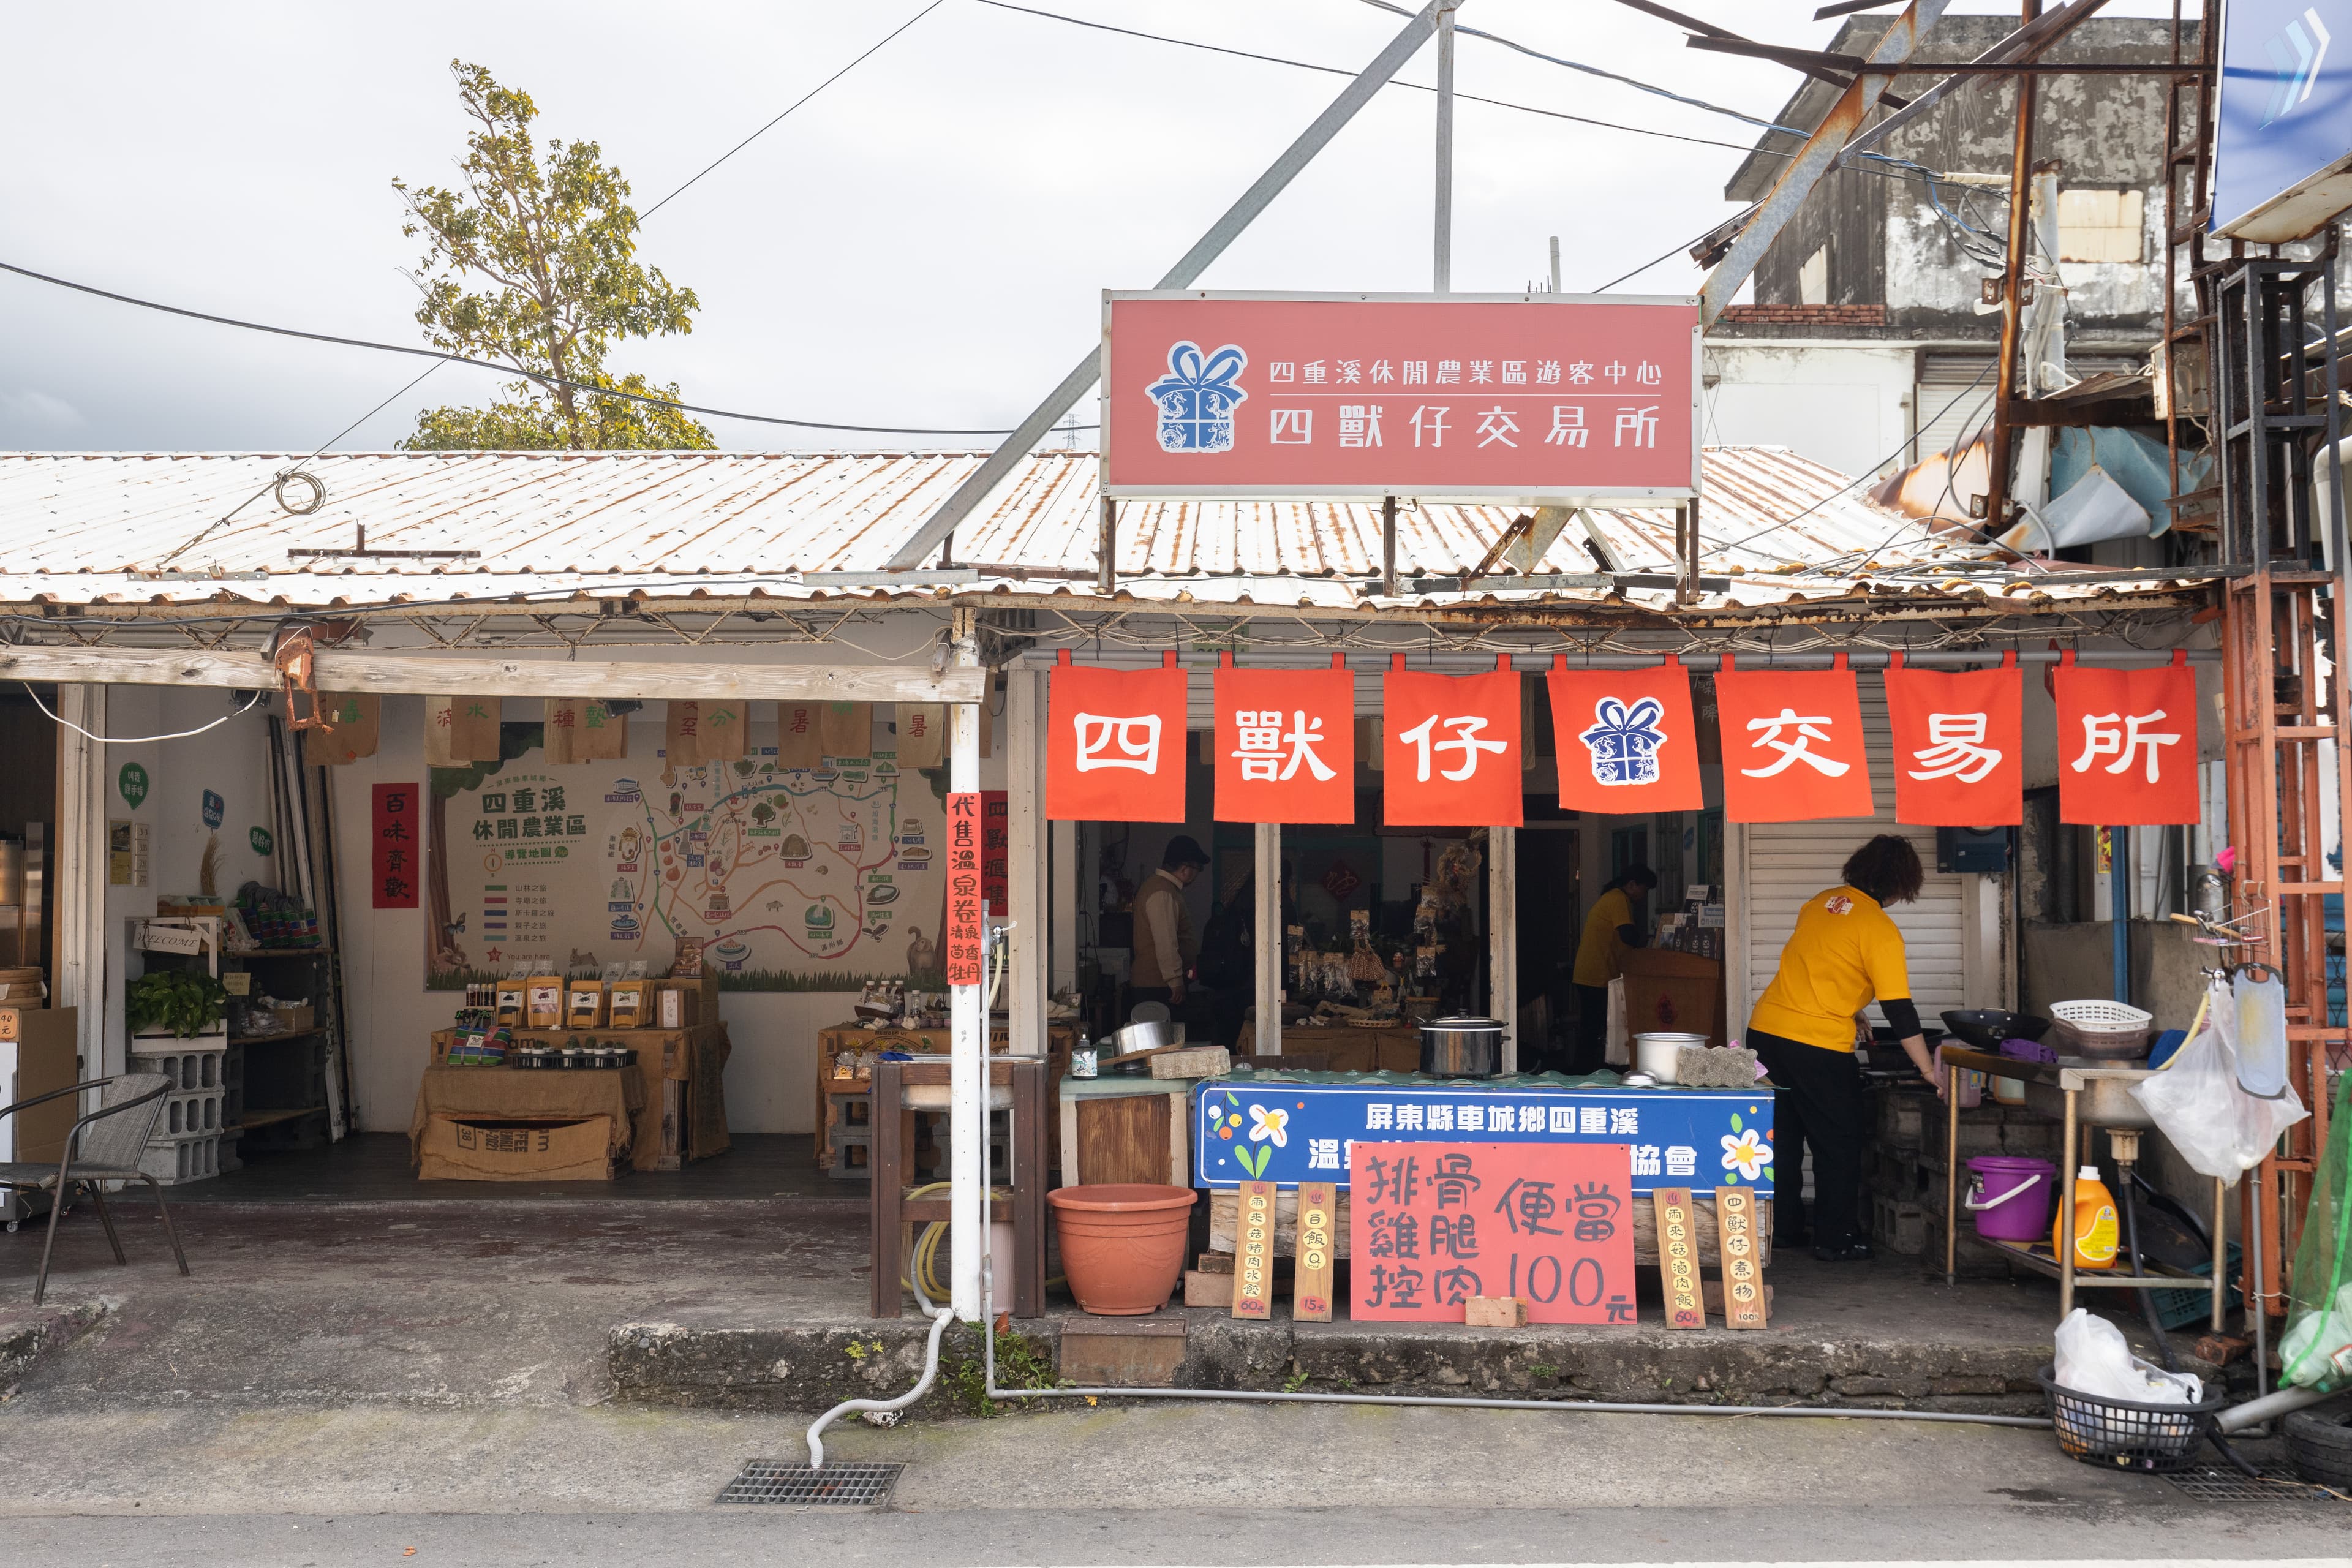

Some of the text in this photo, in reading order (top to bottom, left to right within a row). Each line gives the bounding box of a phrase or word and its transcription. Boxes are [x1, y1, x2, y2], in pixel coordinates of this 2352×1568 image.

[1270, 360, 1662, 385] 四重溪休閒農業區遊客中心
[1270, 405, 1660, 449] 四獸仔交易所
[466, 703, 489, 719] 水
[707, 707, 737, 727] 分
[789, 709, 810, 734] 暑
[908, 715, 927, 737] 暑
[1074, 709, 2181, 784] 四 獸 仔 交 易 所
[482, 786, 566, 814] 四重溪
[472, 815, 586, 840] 休閒農業區
[505, 848, 551, 860] 導覽地圖
[138, 932, 198, 947] WELCOME
[951, 925, 980, 940] 清泉
[951, 944, 979, 960] 茴香
[948, 963, 981, 982] 牡丹
[2, 1025, 11, 1034] 元
[1366, 1104, 1639, 1134] 屏東縣車城鄉四重溪
[1365, 1153, 1621, 1243] 排骨 便當
[1243, 1197, 1264, 1296] 雨來菇豬肉水餃
[1368, 1210, 1480, 1260] 雞腿
[1727, 1197, 1752, 1298] 四獸仔煮物
[1668, 1209, 1692, 1306] 雨來菇滷肉飯
[1365, 1264, 1482, 1310] 控肉
[1240, 1300, 1265, 1313] 60元
[1305, 1299, 1325, 1312] 15元
[1675, 1311, 1700, 1324] 60元
